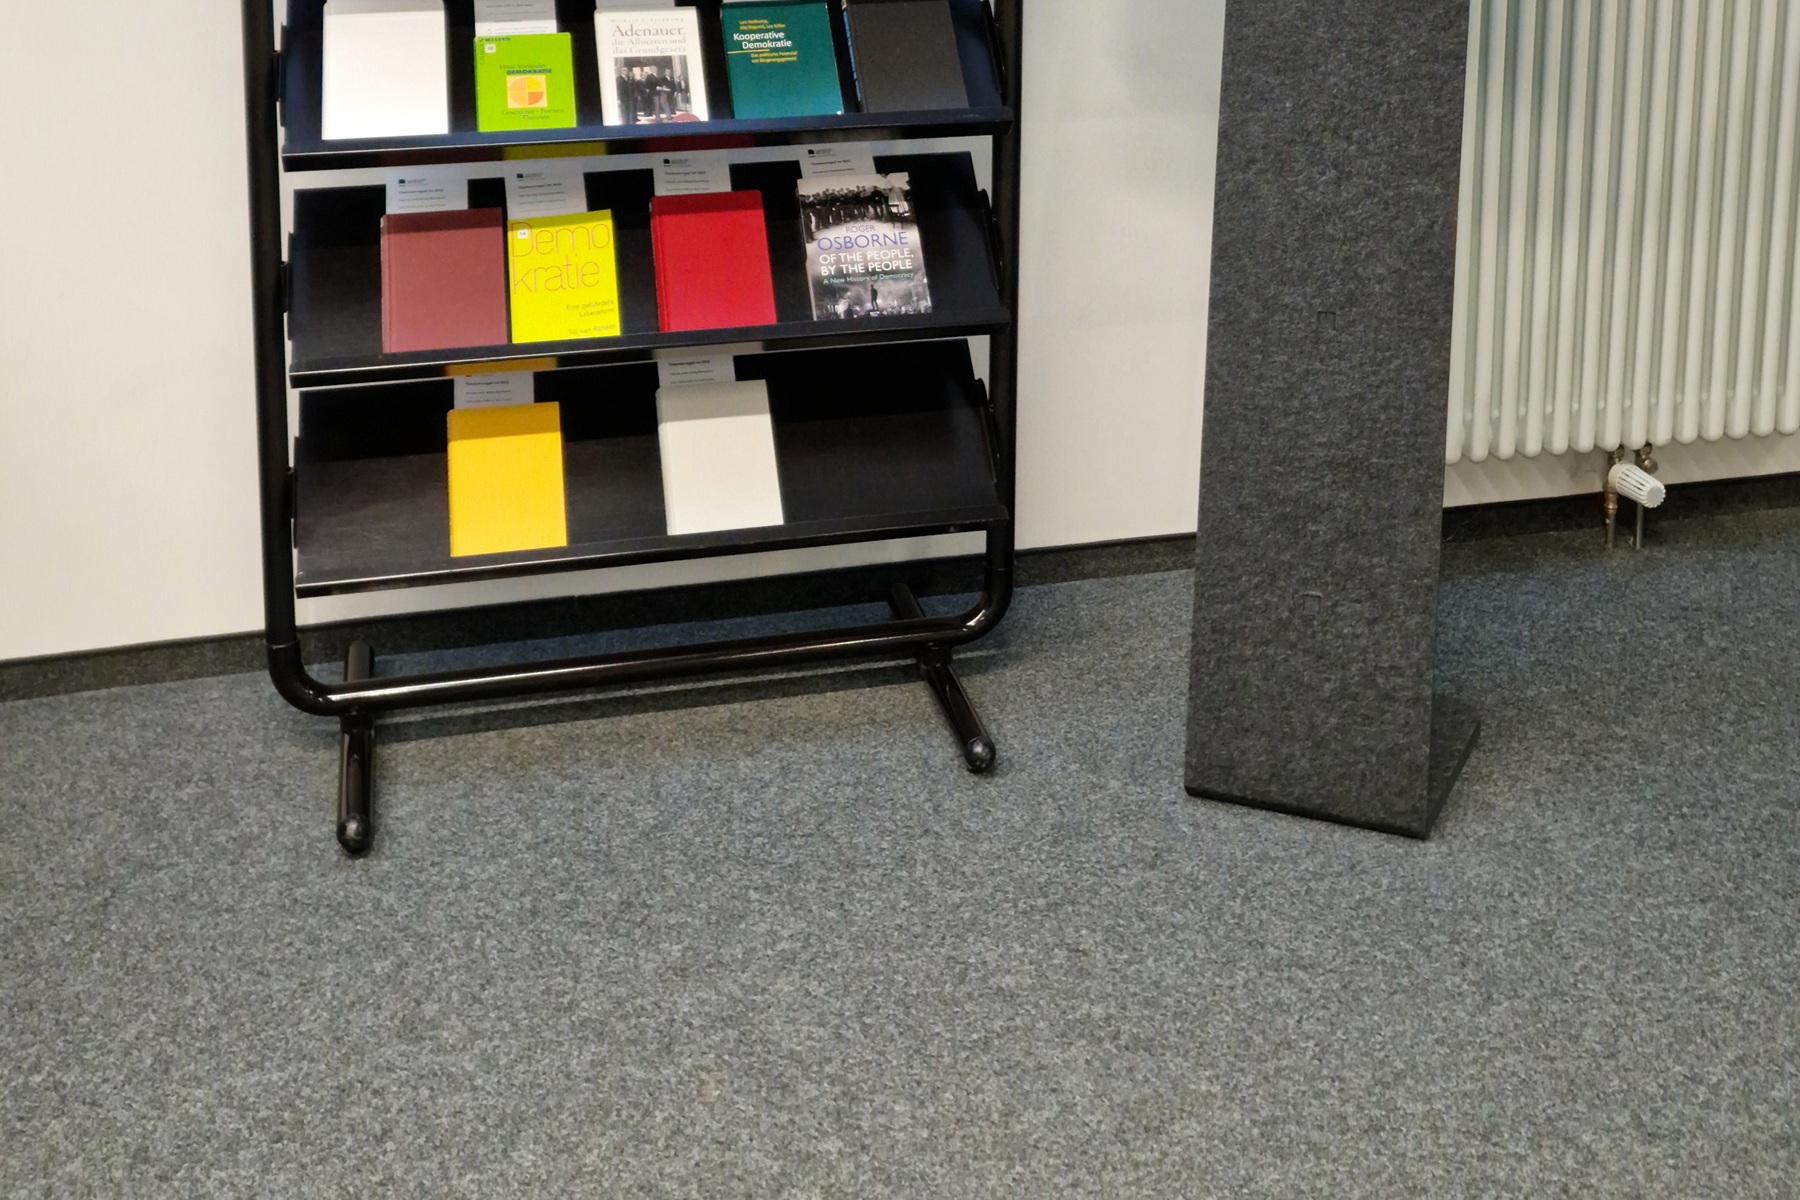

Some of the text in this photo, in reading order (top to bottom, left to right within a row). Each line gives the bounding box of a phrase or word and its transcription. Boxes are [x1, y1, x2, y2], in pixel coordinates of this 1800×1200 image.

[734, 31, 784, 42] Kooperative
[742, 39, 792, 50] Demokratie
[846, 224, 876, 234] ROGER
[511, 222, 610, 258] Demo
[817, 231, 909, 251] OSBORNE
[819, 248, 914, 264] OF THE PEOPLE,
[512, 253, 600, 295] kratie
[821, 259, 913, 276] BY THE PEOPLE
[846, 275, 870, 284] History
[879, 272, 914, 281] Democracy
